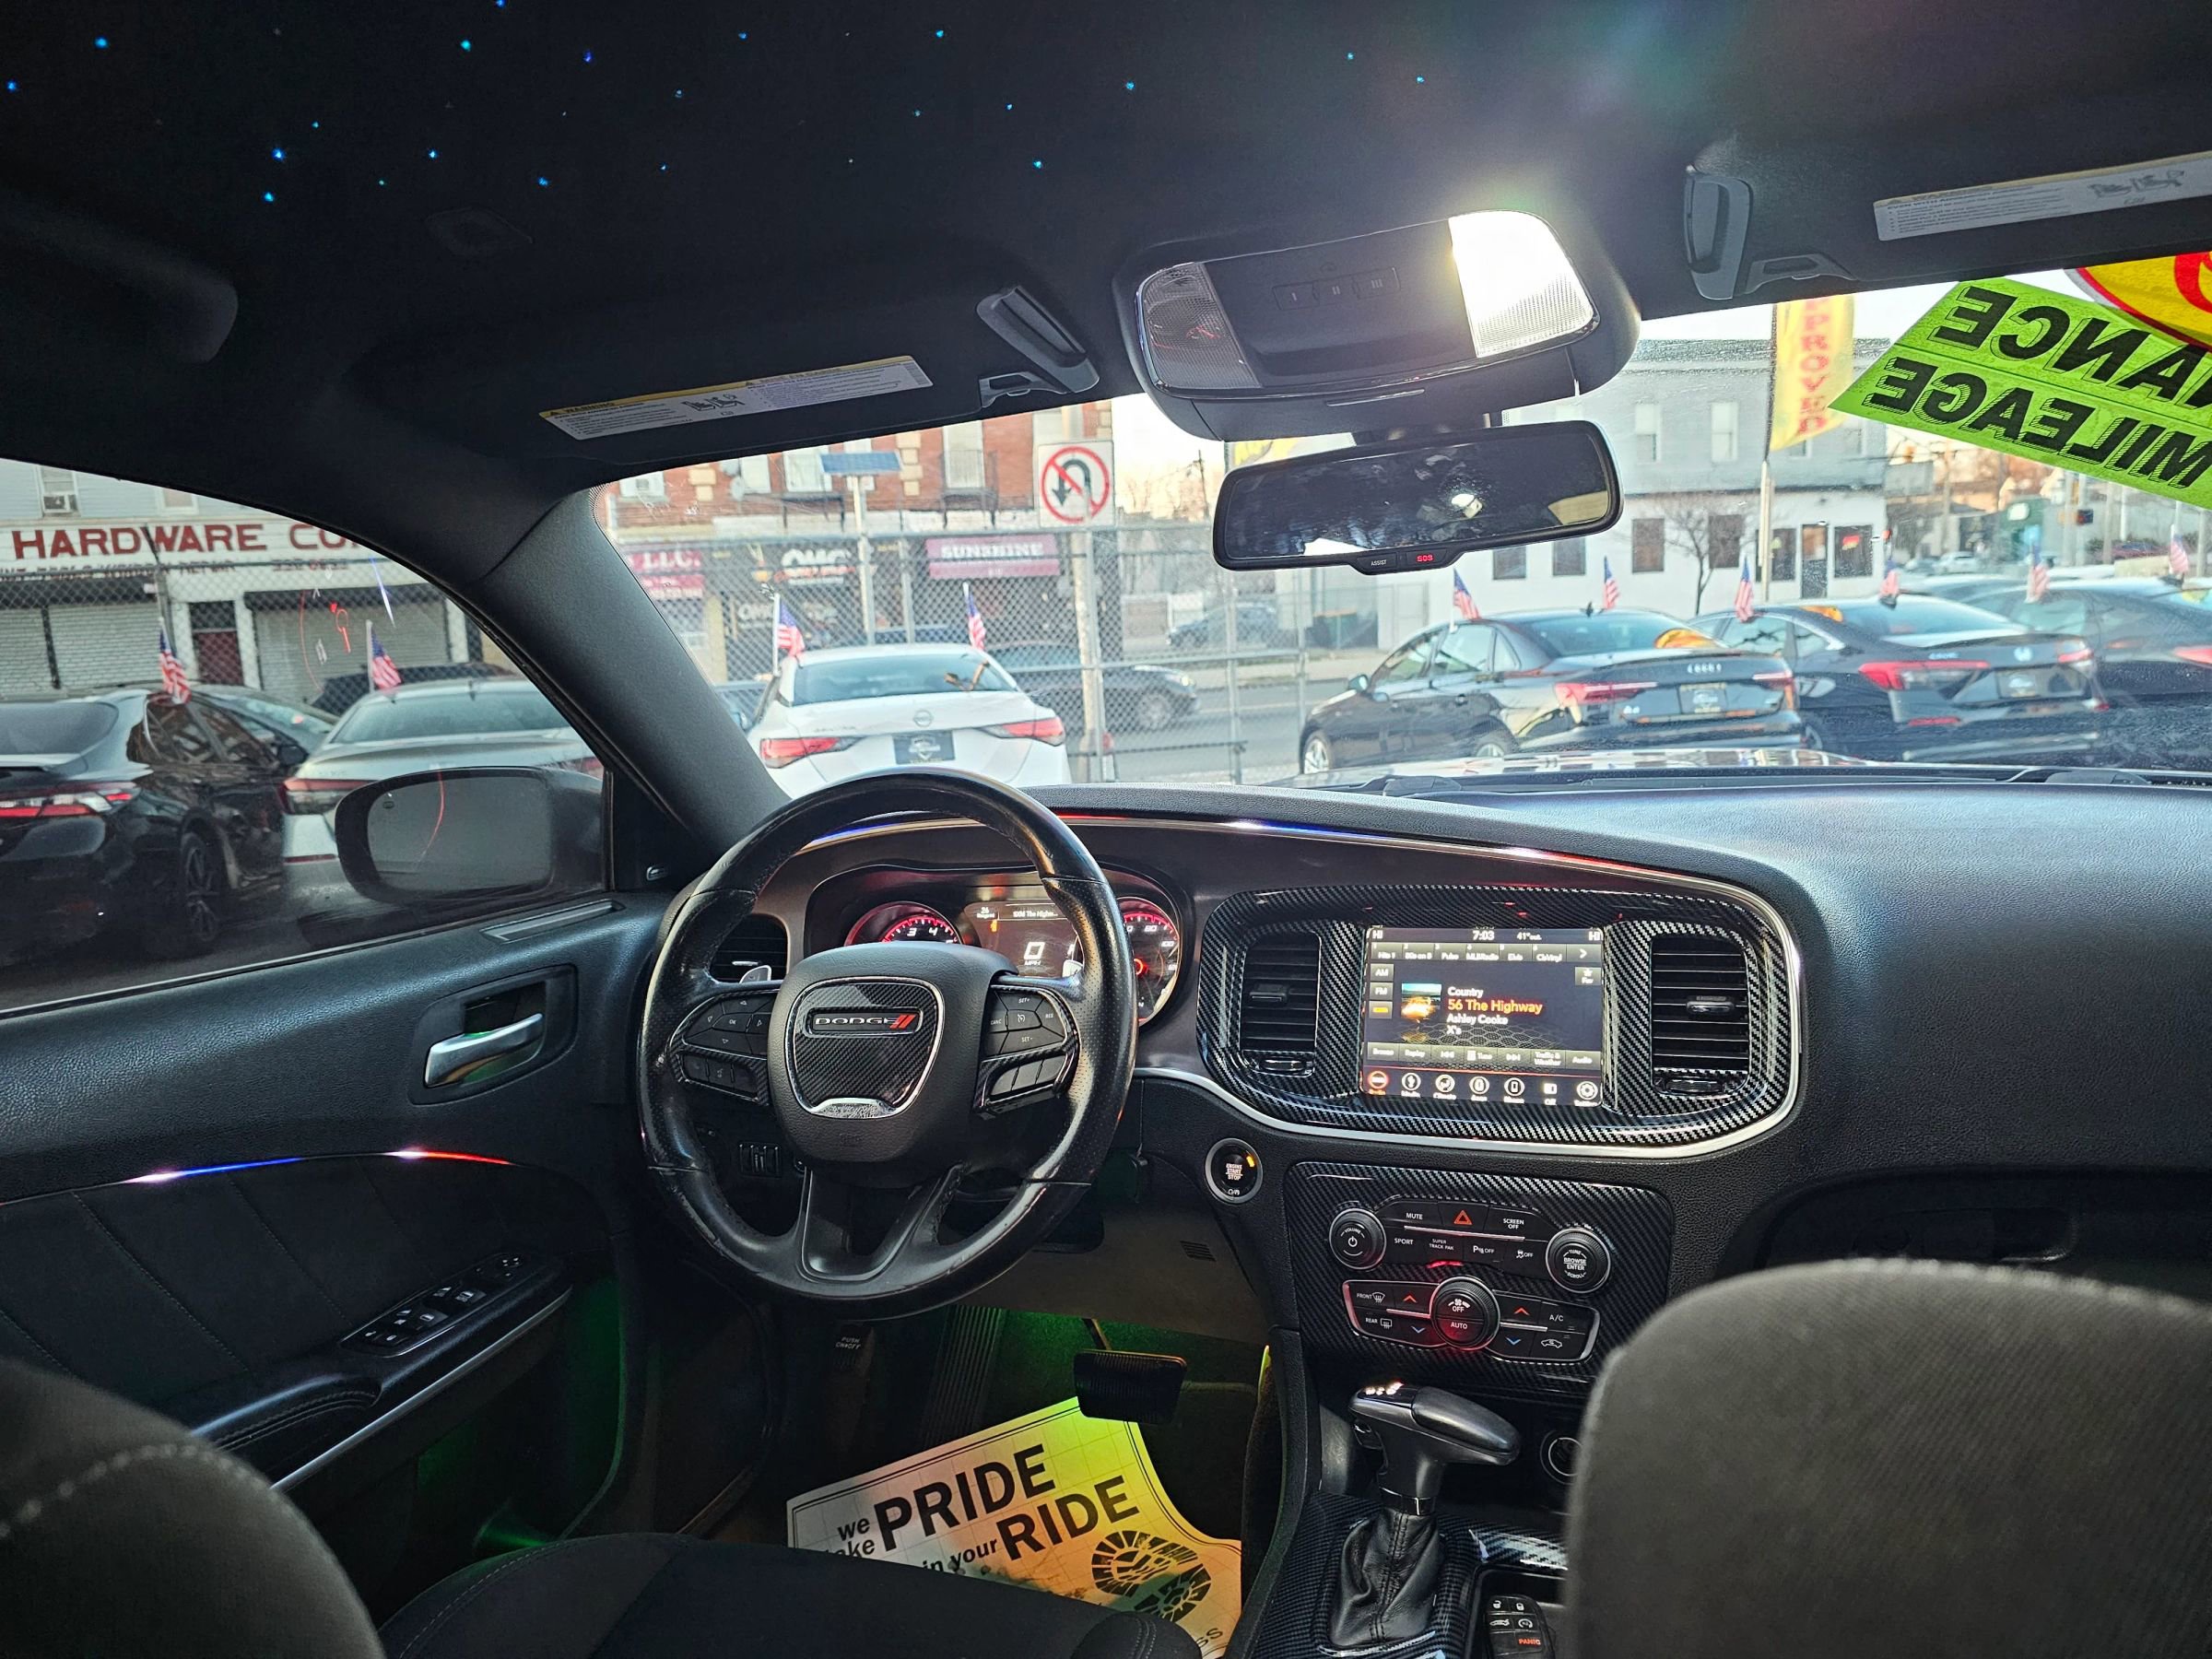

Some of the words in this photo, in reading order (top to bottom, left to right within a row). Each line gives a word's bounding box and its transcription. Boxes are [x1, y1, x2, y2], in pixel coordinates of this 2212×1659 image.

[12, 524, 267, 559] HARDWARE
[907, 927, 917, 936] 3
[928, 927, 937, 935] 4
[1473, 930, 1494, 940] 7:03
[1024, 942, 1045, 959] 0
[1447, 986, 1483, 998] Country
[1448, 999, 1463, 1010] 56
[1465, 998, 1488, 1011] The
[1491, 1000, 1543, 1014] Highway
[1447, 1014, 1477, 1025] Ashley
[1406, 1212, 1423, 1220] MUTE
[1345, 1227, 1361, 1235] VOLUME
[1394, 1237, 1414, 1245] SPORT
[1451, 1322, 1468, 1330] AUTO
[874, 1443, 1055, 1551] PRIDE
[996, 1475, 1140, 1560] RIDE
[837, 1517, 870, 1541] we
[827, 1538, 876, 1558] ake
[949, 1538, 997, 1567] your
